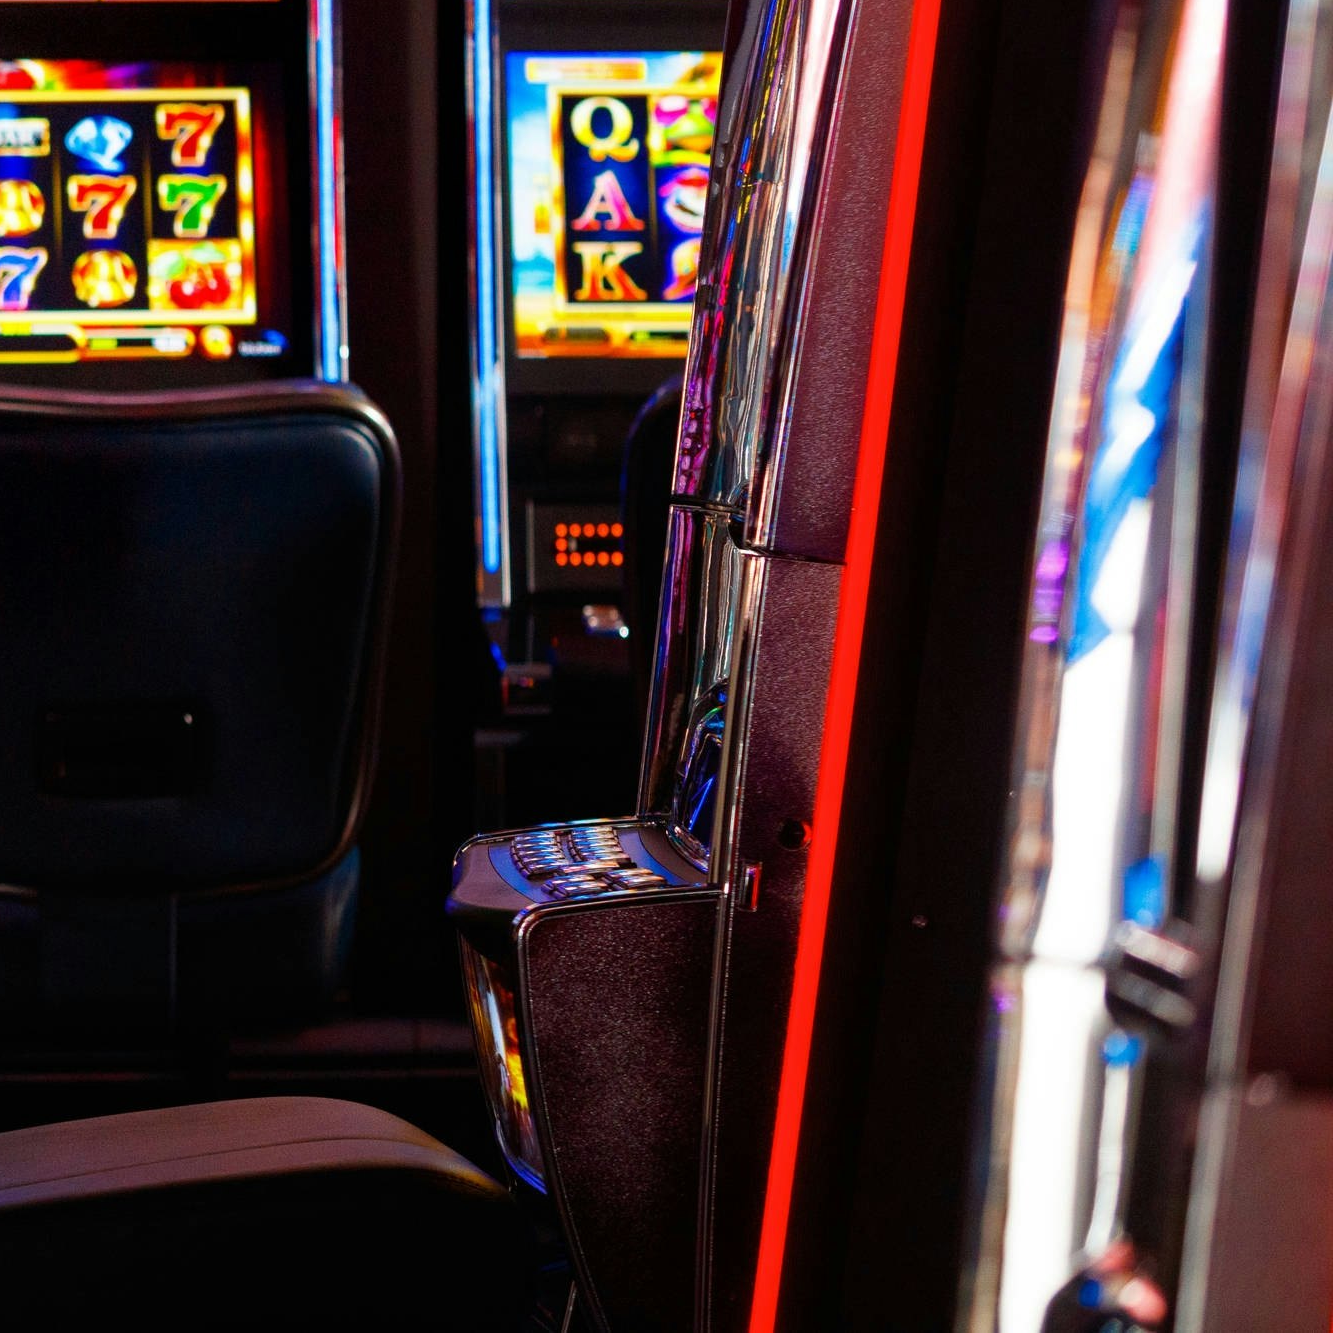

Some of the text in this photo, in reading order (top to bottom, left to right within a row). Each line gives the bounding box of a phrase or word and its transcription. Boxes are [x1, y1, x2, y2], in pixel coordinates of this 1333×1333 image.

[156, 103, 224, 167] 7
[569, 96, 639, 161] Q
[68, 175, 137, 239] 7
[158, 175, 227, 237] 7
[572, 170, 645, 231] A
[572, 241, 648, 301] K
